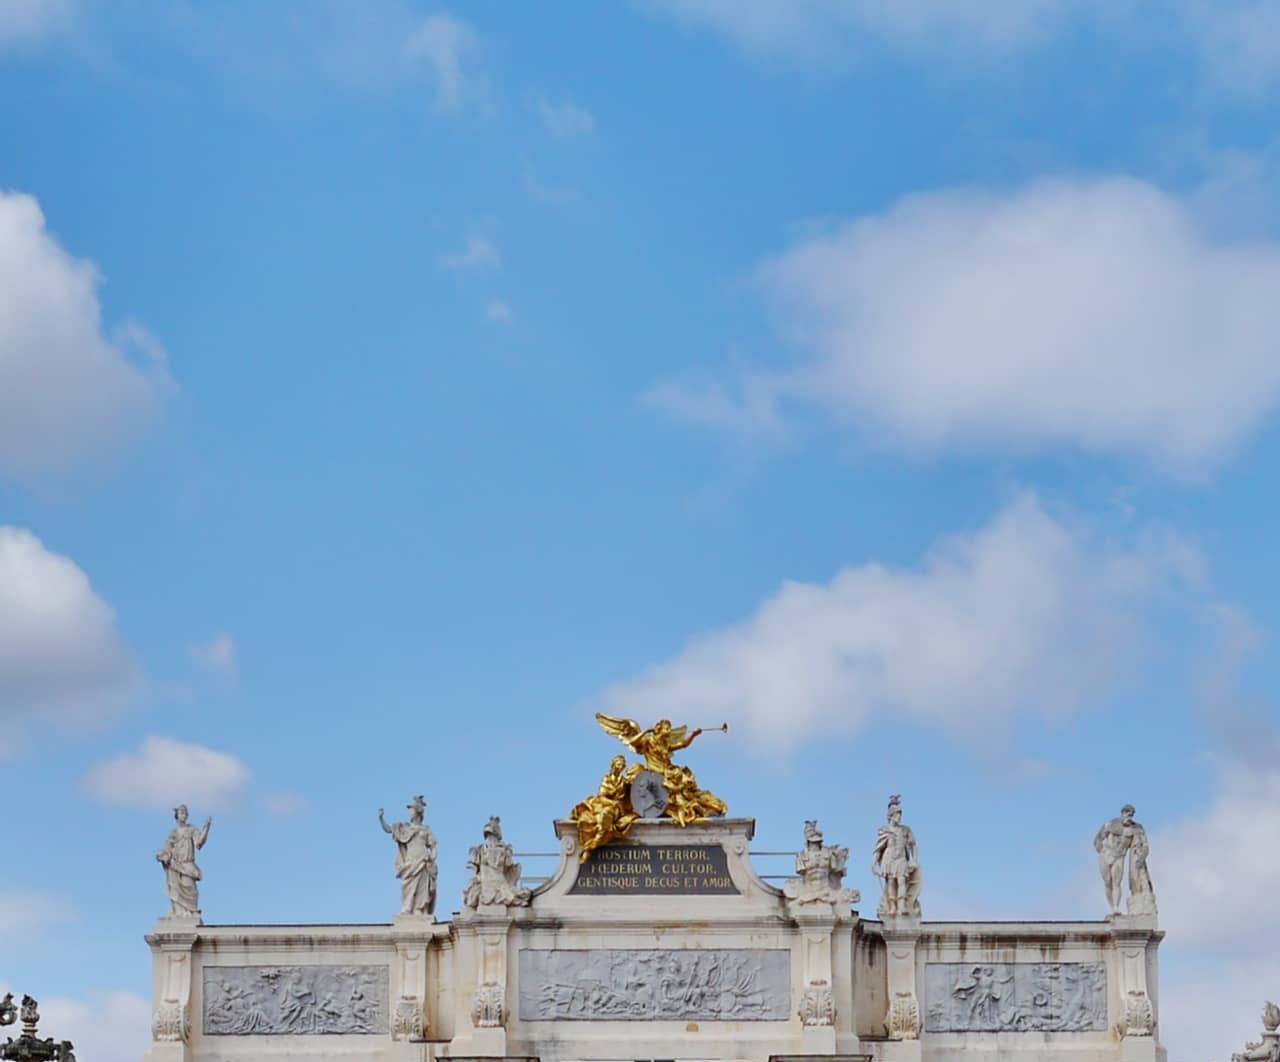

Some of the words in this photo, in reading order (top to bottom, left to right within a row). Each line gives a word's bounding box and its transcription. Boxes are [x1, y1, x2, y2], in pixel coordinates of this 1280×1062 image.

[578, 876, 640, 889] GENTISQUE
[645, 876, 680, 888] DECUS
[684, 877, 698, 888] ET
